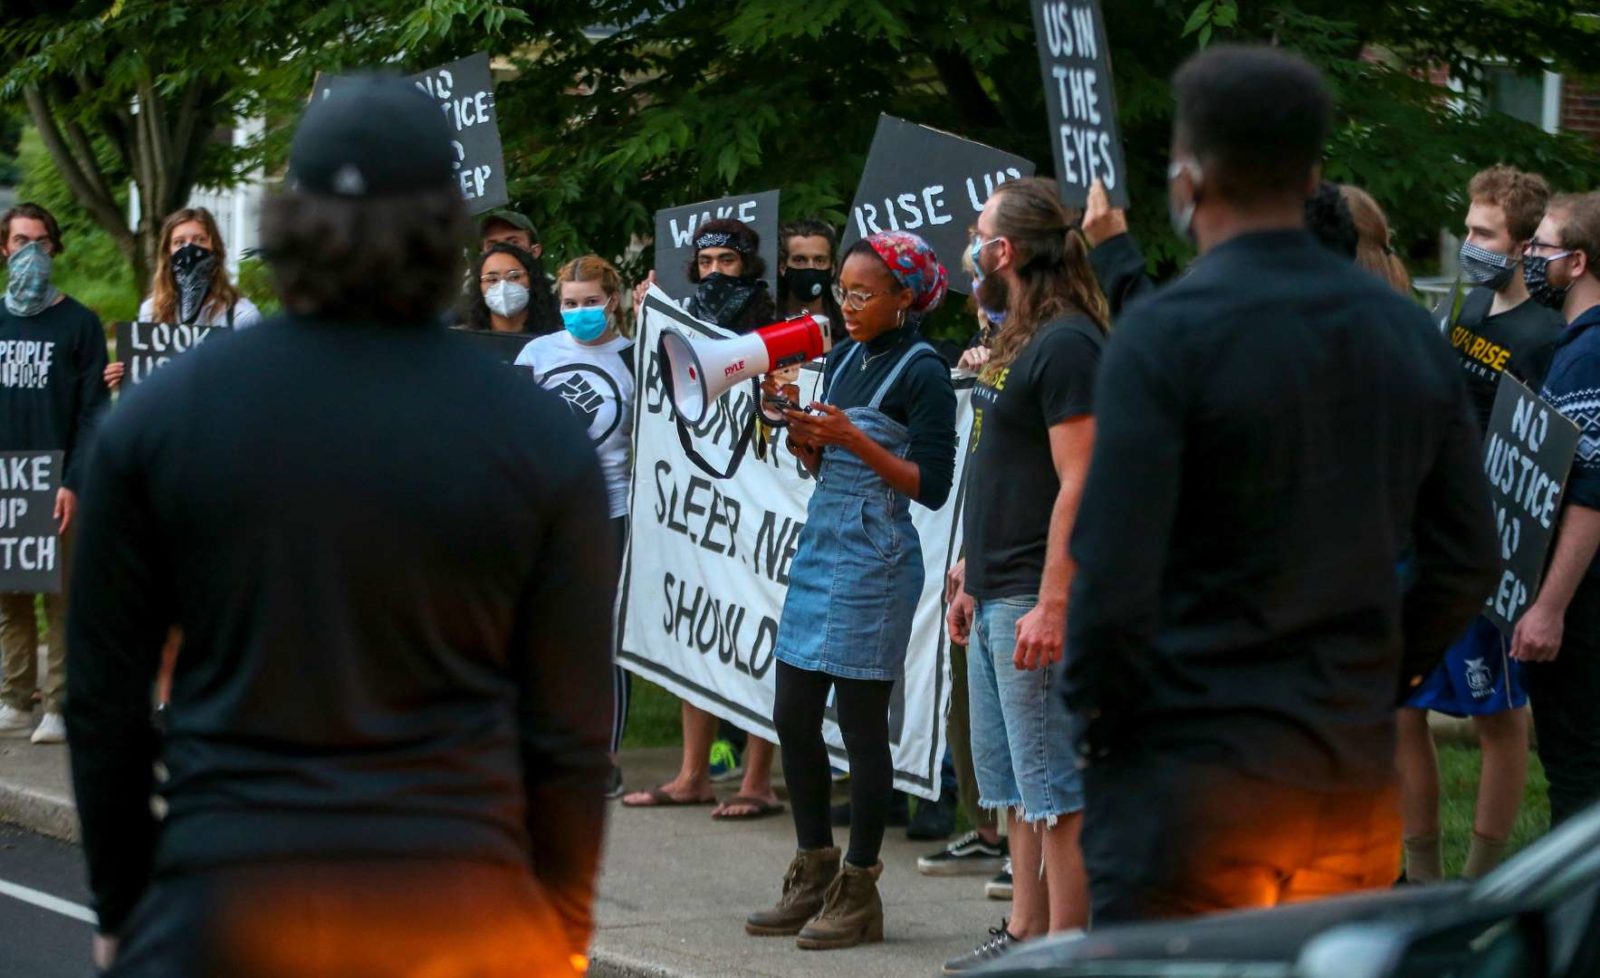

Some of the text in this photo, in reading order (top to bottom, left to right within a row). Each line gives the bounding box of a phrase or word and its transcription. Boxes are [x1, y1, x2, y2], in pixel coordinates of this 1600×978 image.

[1043, 2, 1097, 60] US IN
[1052, 66, 1101, 125] THE
[1060, 124, 1115, 190] EYES
[855, 185, 953, 239] RISE
[1511, 396, 1549, 453] NO
[664, 572, 779, 680] SHOULD
